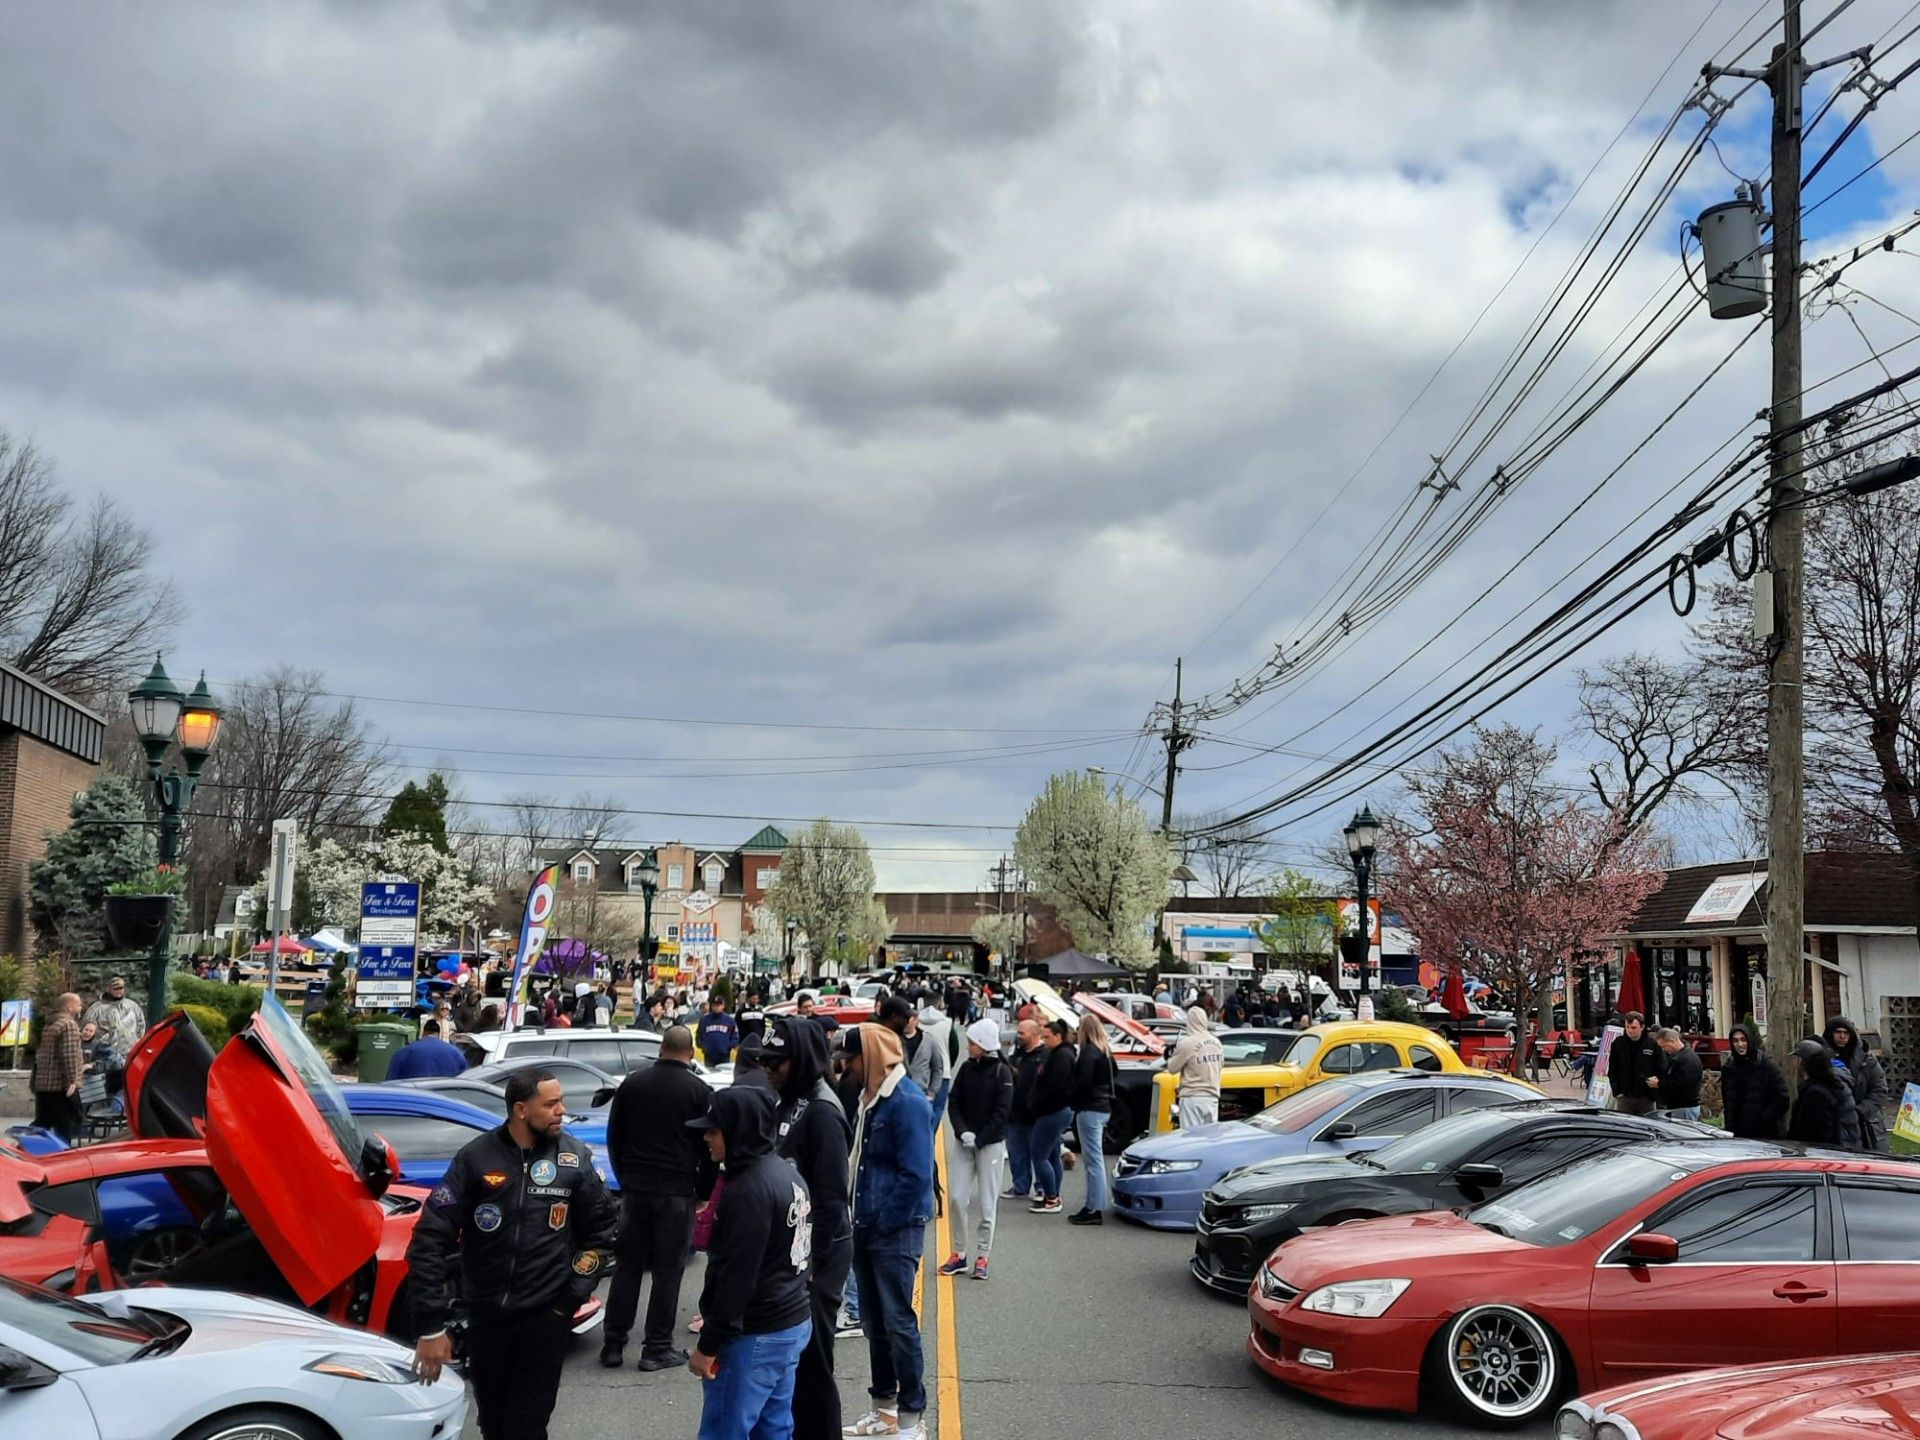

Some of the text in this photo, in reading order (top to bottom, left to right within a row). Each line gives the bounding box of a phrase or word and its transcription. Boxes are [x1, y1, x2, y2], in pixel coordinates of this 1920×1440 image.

[287, 826, 295, 866] STOP
[370, 906, 408, 915] Development
[1342, 960, 1378, 969] COEE
[373, 969, 398, 977] Realty
